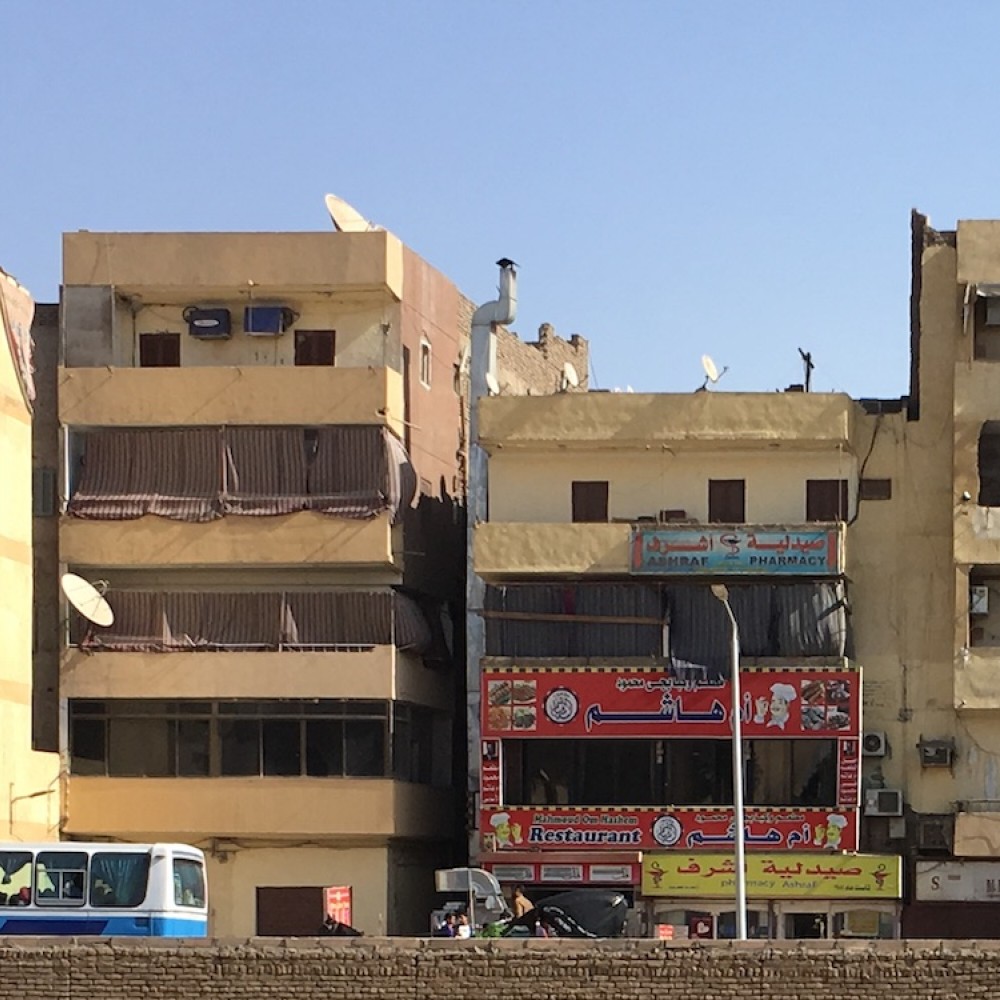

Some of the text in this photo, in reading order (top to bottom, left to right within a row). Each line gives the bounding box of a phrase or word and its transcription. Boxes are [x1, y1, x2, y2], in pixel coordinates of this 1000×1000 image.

[747, 533, 826, 554] صيدلية
[647, 556, 826, 566] ASHRAF PHARMACY
[616, 677, 645, 692] محمود
[584, 691, 726, 732] هاشم
[533, 813, 639, 825] Mahmoud Om Hashem
[695, 814, 728, 823] محمود
[529, 826, 642, 843] Restaurant
[787, 823, 811, 848] أم
[761, 859, 862, 879] صيدلية
